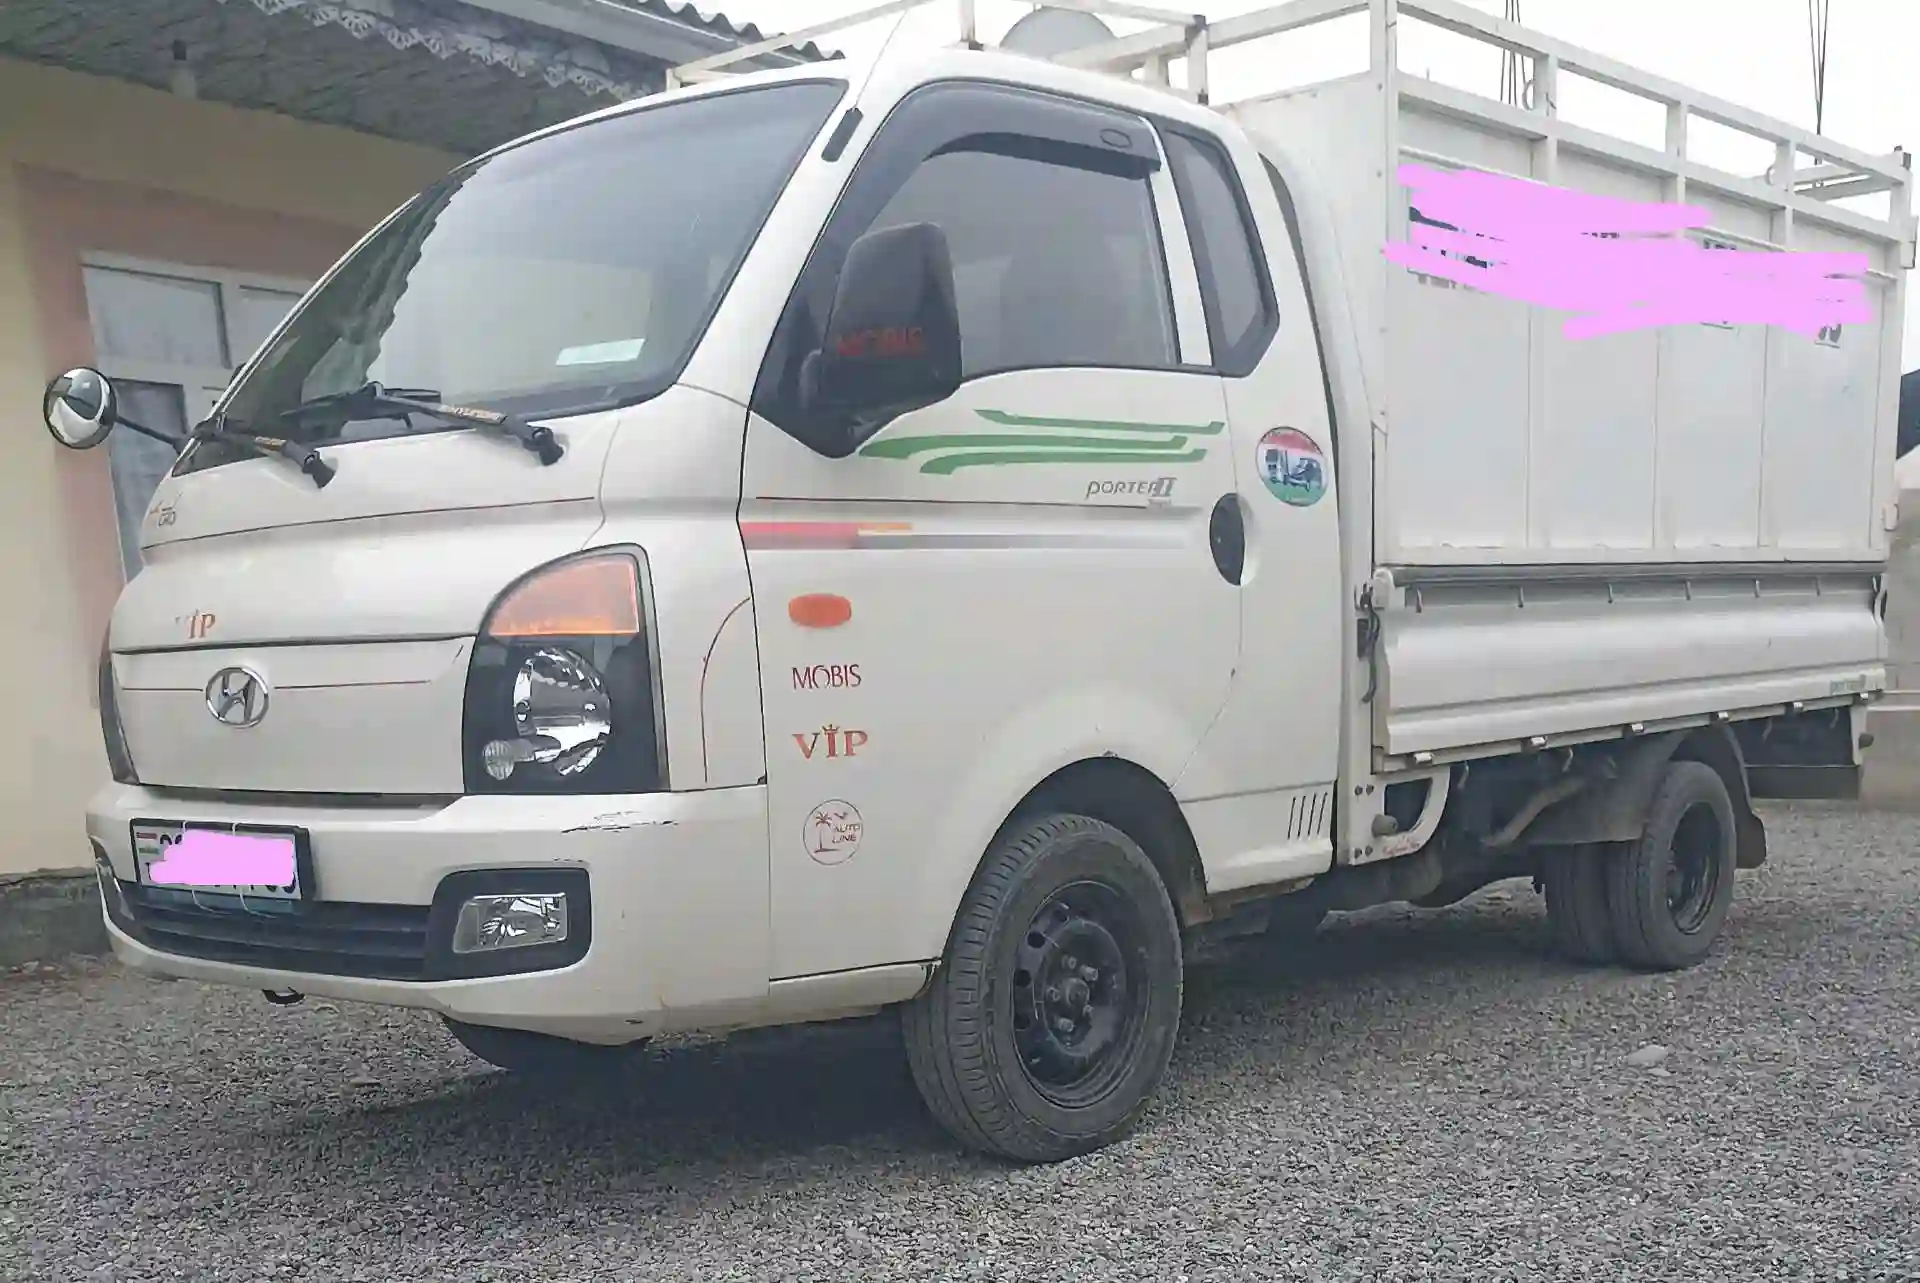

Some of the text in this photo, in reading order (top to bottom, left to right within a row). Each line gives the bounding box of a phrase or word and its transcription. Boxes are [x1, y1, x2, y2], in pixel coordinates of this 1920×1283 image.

[174, 609, 216, 639] IP
[792, 663, 862, 689] MOBIS
[792, 724, 868, 759] VIP
